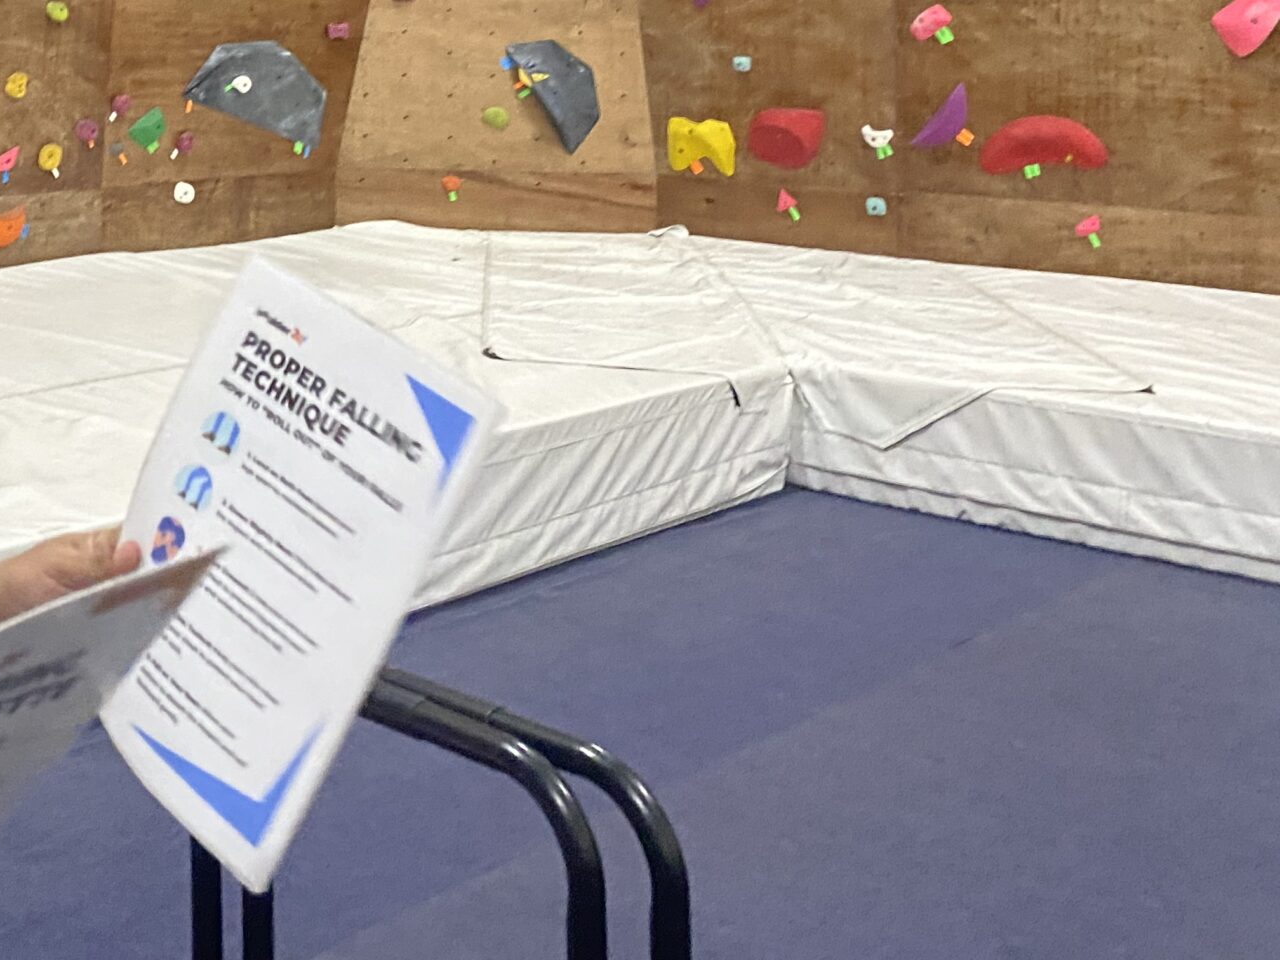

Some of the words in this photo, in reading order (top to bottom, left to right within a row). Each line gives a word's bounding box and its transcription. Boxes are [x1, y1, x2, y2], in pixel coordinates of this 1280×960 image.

[231, 352, 353, 447] TECHNIQUE
[241, 330, 328, 400] PROPER
[328, 387, 426, 465] FALLING
[246, 394, 261, 411] TO
